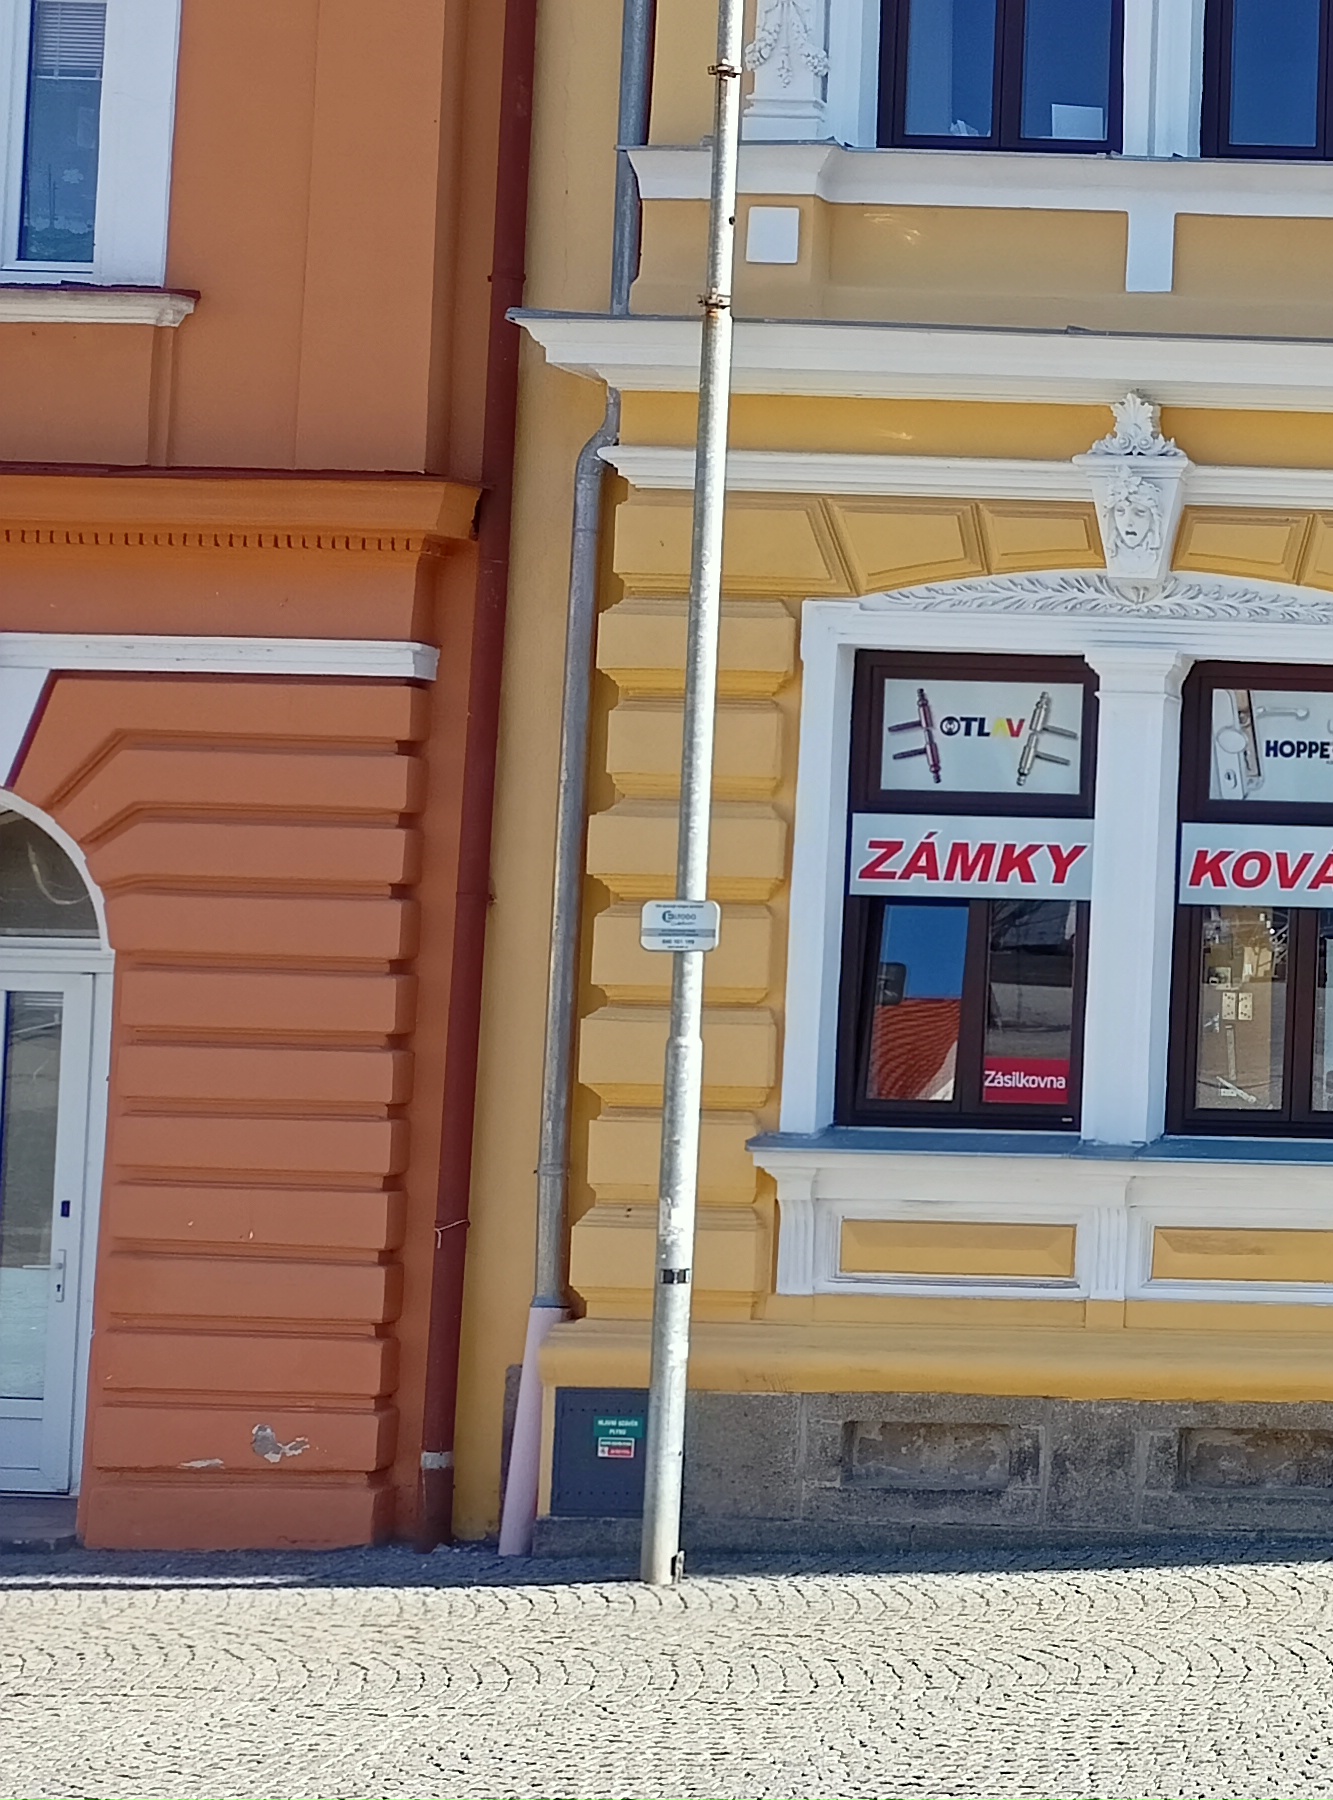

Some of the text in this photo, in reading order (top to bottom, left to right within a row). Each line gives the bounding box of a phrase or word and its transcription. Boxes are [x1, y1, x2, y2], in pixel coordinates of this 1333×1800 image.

[939, 716, 1026, 739] OTLAV
[1265, 740, 1331, 759] HOPPE
[858, 830, 1089, 884] ZÁMKY
[984, 1069, 1067, 1091] Zásilkovna
